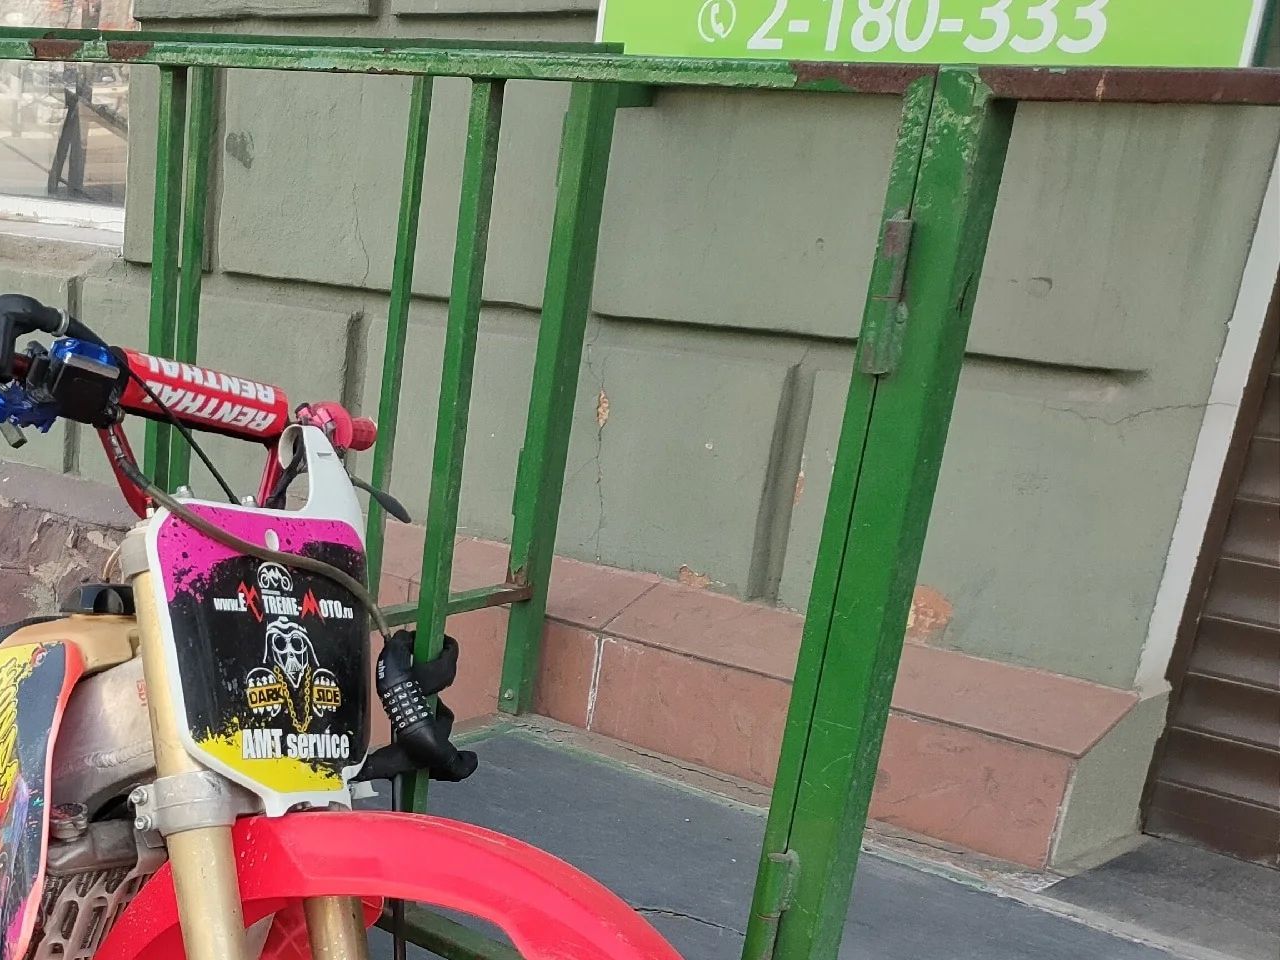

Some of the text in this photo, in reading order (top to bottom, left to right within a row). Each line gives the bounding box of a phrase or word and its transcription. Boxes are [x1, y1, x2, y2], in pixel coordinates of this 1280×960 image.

[147, 354, 277, 403] RENTHAL
[139, 377, 279, 433] RENTHAL
[248, 686, 282, 705] DARK
[243, 728, 350, 759] AMT service
